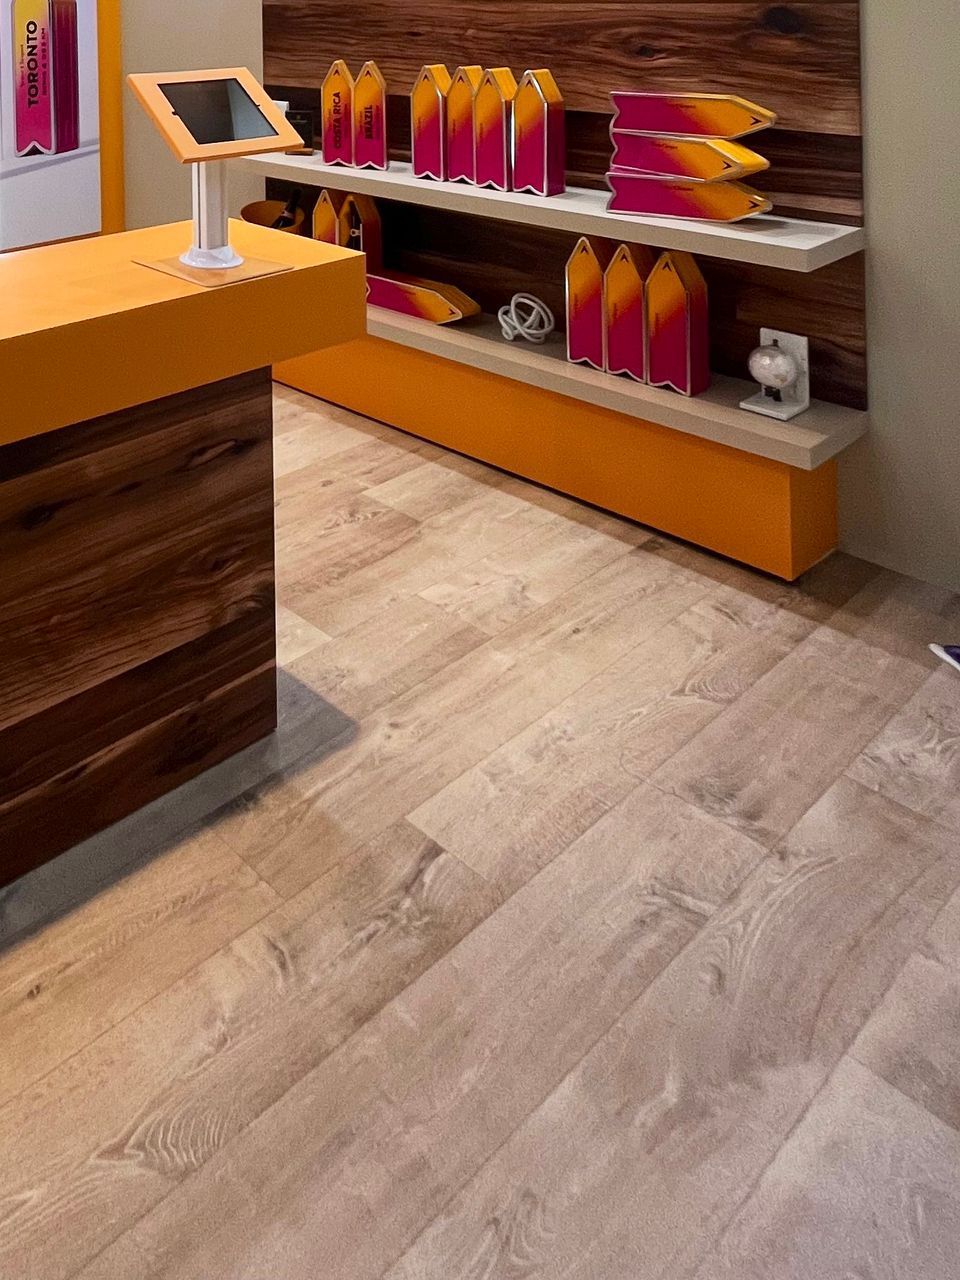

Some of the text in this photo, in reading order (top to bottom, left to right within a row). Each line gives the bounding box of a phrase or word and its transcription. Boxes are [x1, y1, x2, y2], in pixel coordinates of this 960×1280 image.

[26, 20, 39, 108] TORONTO
[332, 91, 341, 115] RICA
[364, 104, 373, 140] BRAZIL
